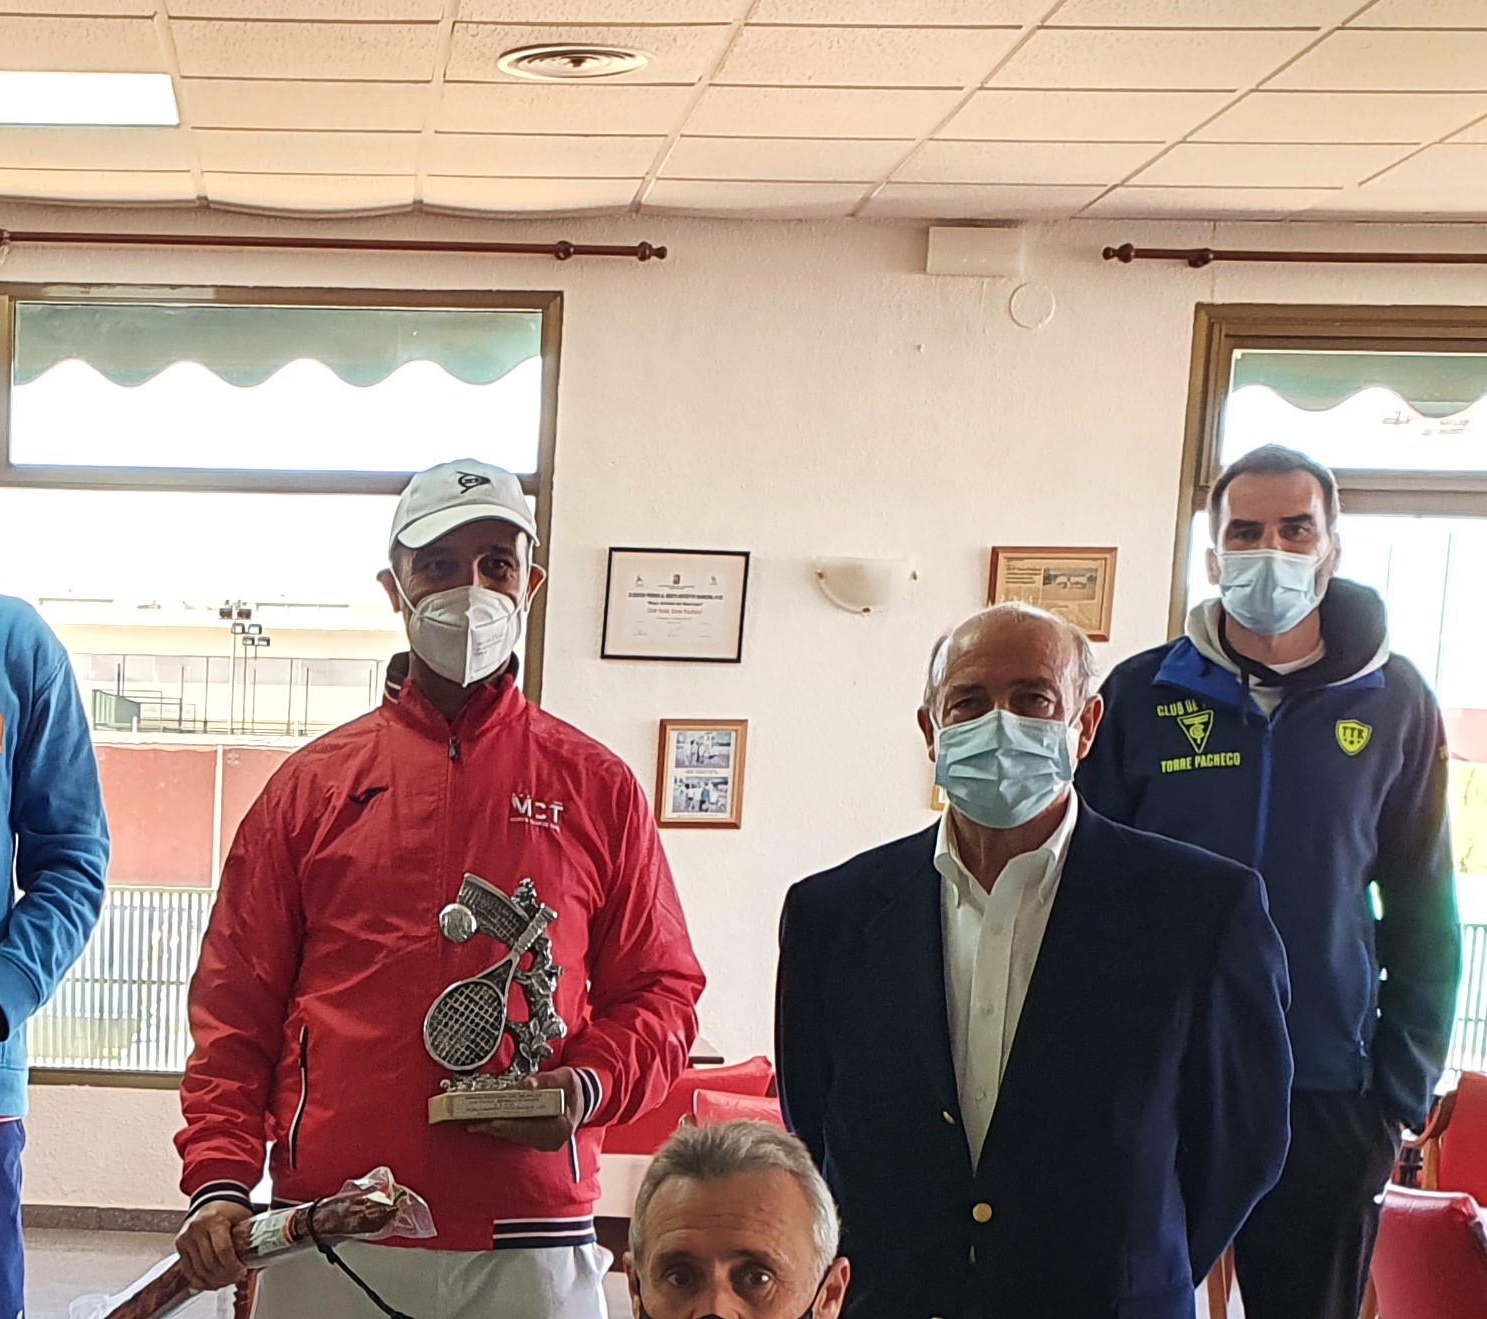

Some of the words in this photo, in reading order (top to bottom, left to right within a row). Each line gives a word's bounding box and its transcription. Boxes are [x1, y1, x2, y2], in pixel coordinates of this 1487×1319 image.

[1157, 701, 1184, 717] CLUB
[1161, 755, 1192, 773] TORRE
[1194, 752, 1241, 768] PACHECO
